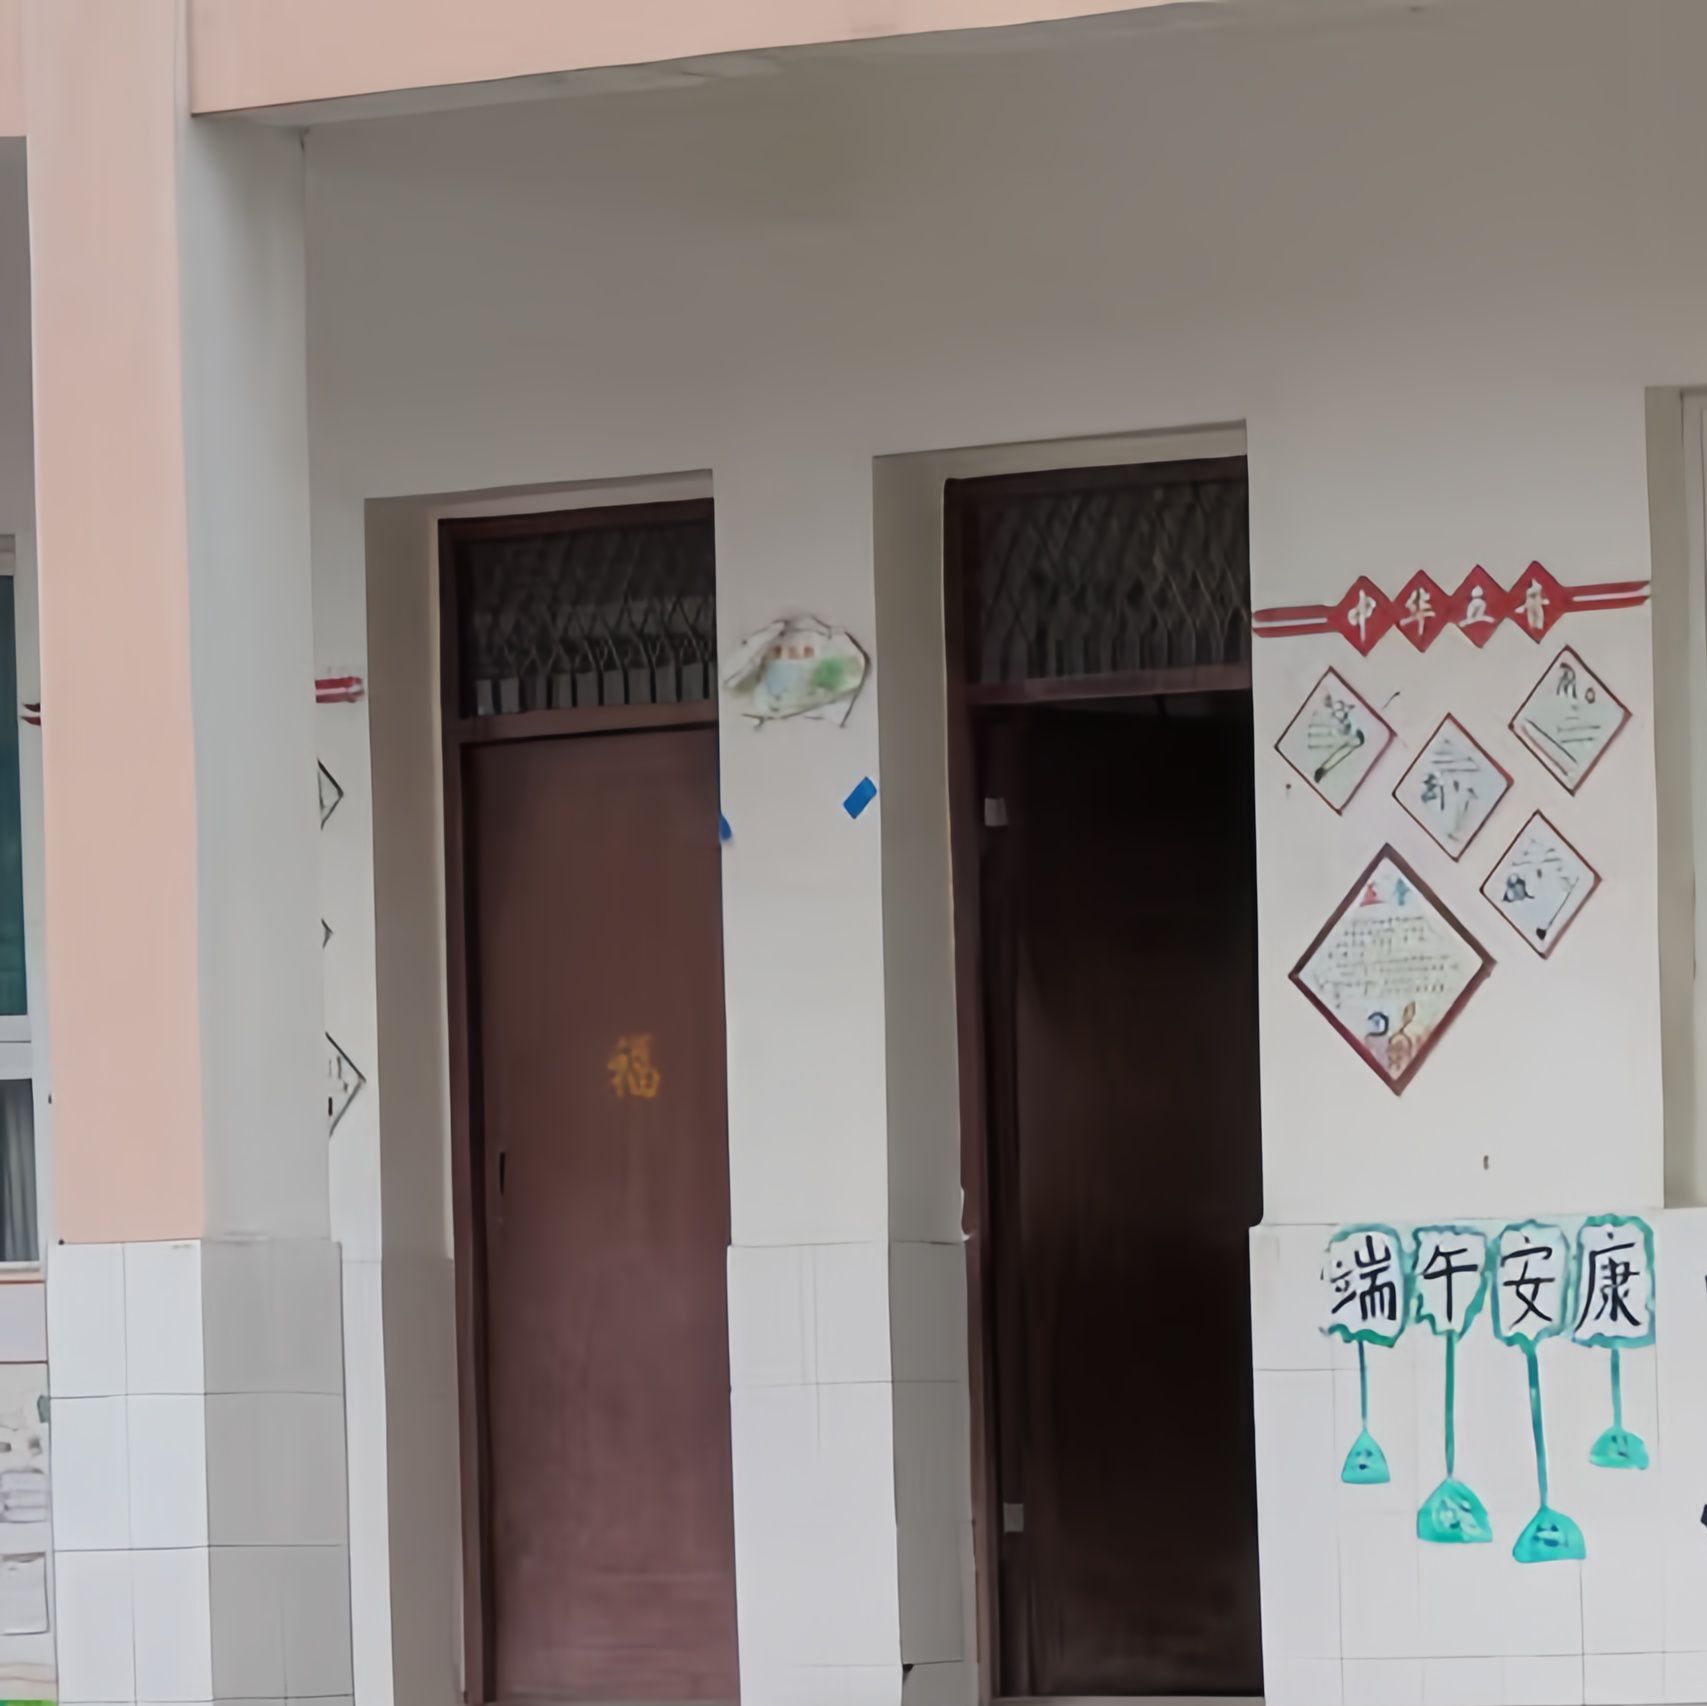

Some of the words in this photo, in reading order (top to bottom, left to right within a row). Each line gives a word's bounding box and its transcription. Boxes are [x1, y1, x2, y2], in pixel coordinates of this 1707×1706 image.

[607, 1034, 660, 1099] 福
[1331, 1231, 1641, 1333] 端午安康
